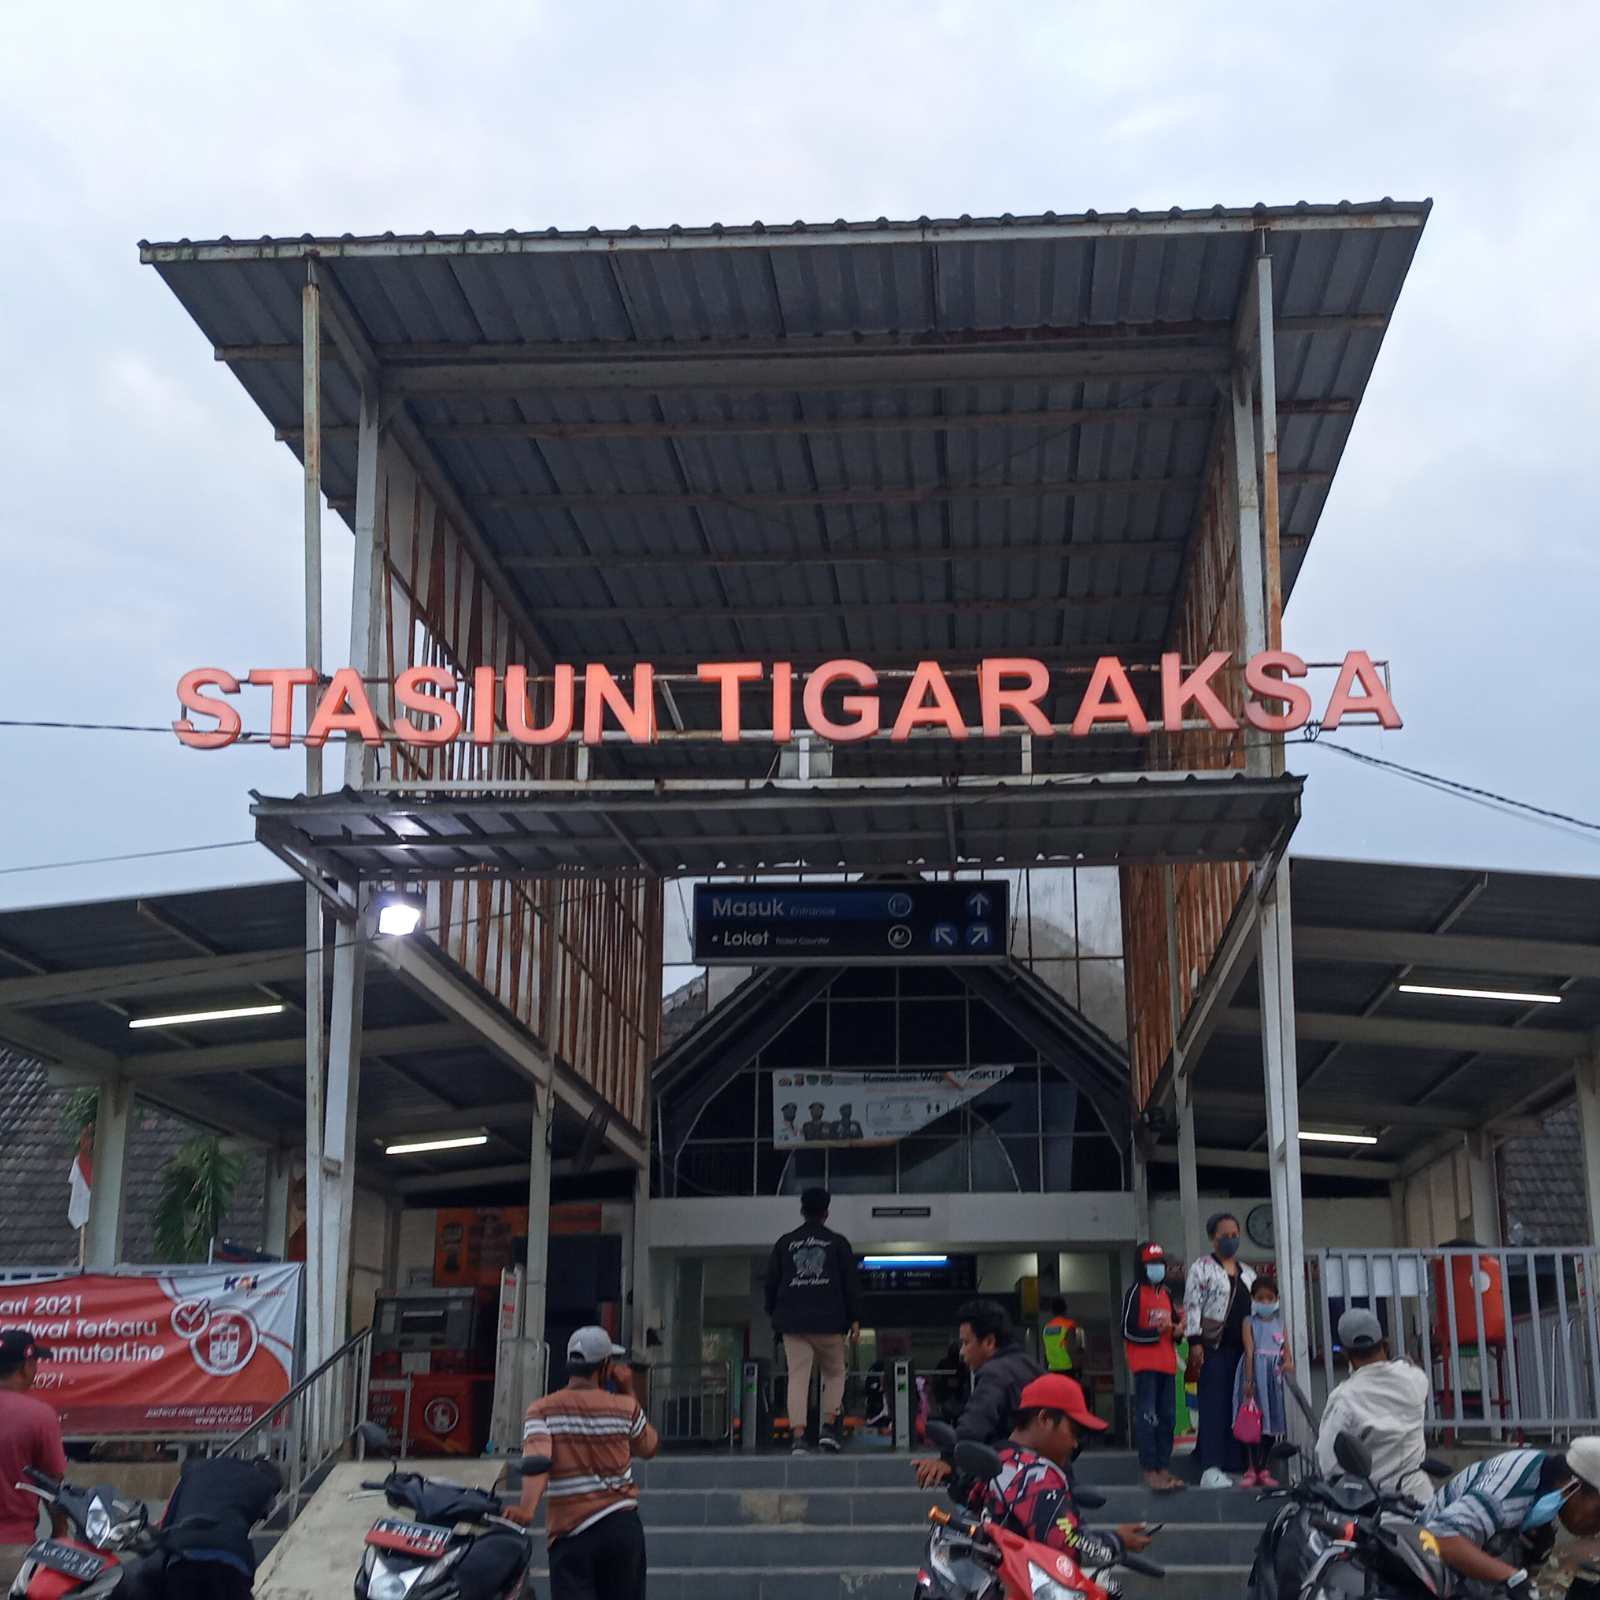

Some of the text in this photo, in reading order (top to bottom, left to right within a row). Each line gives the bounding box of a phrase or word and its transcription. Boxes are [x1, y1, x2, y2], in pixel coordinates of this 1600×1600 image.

[172, 650, 1402, 750] STASIUN TIGARAKSA
[711, 897, 836, 917] Masuk Entrance
[723, 929, 770, 946] Loket
[223, 1273, 260, 1291] KAI
[33, 1294, 82, 1316] 2021
[75, 1318, 158, 1339] Terbaru
